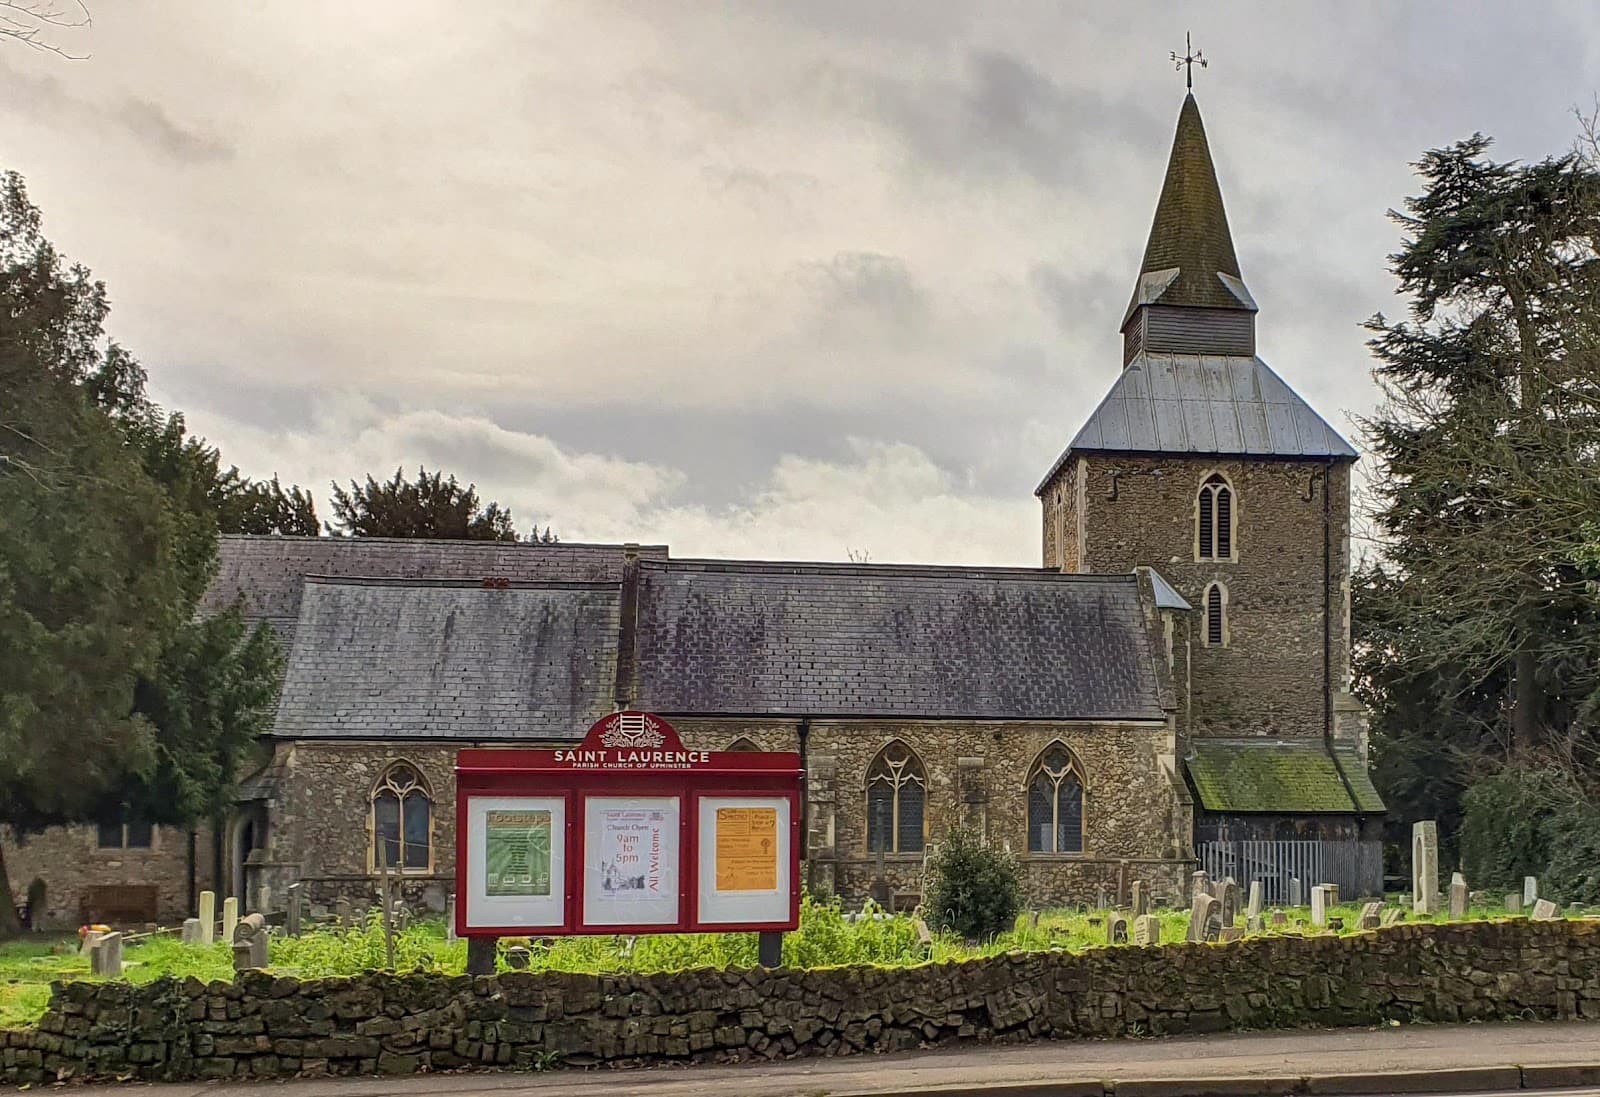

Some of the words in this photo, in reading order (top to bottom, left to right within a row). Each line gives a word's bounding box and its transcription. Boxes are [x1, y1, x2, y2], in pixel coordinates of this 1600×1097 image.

[554, 750, 607, 761] SAINT
[617, 751, 710, 762] LAURENCE
[632, 824, 649, 832] Open
[617, 834, 639, 843] 9am
[649, 827, 659, 873] Welcome
[616, 853, 639, 864] 5pm
[649, 876, 659, 892] All
